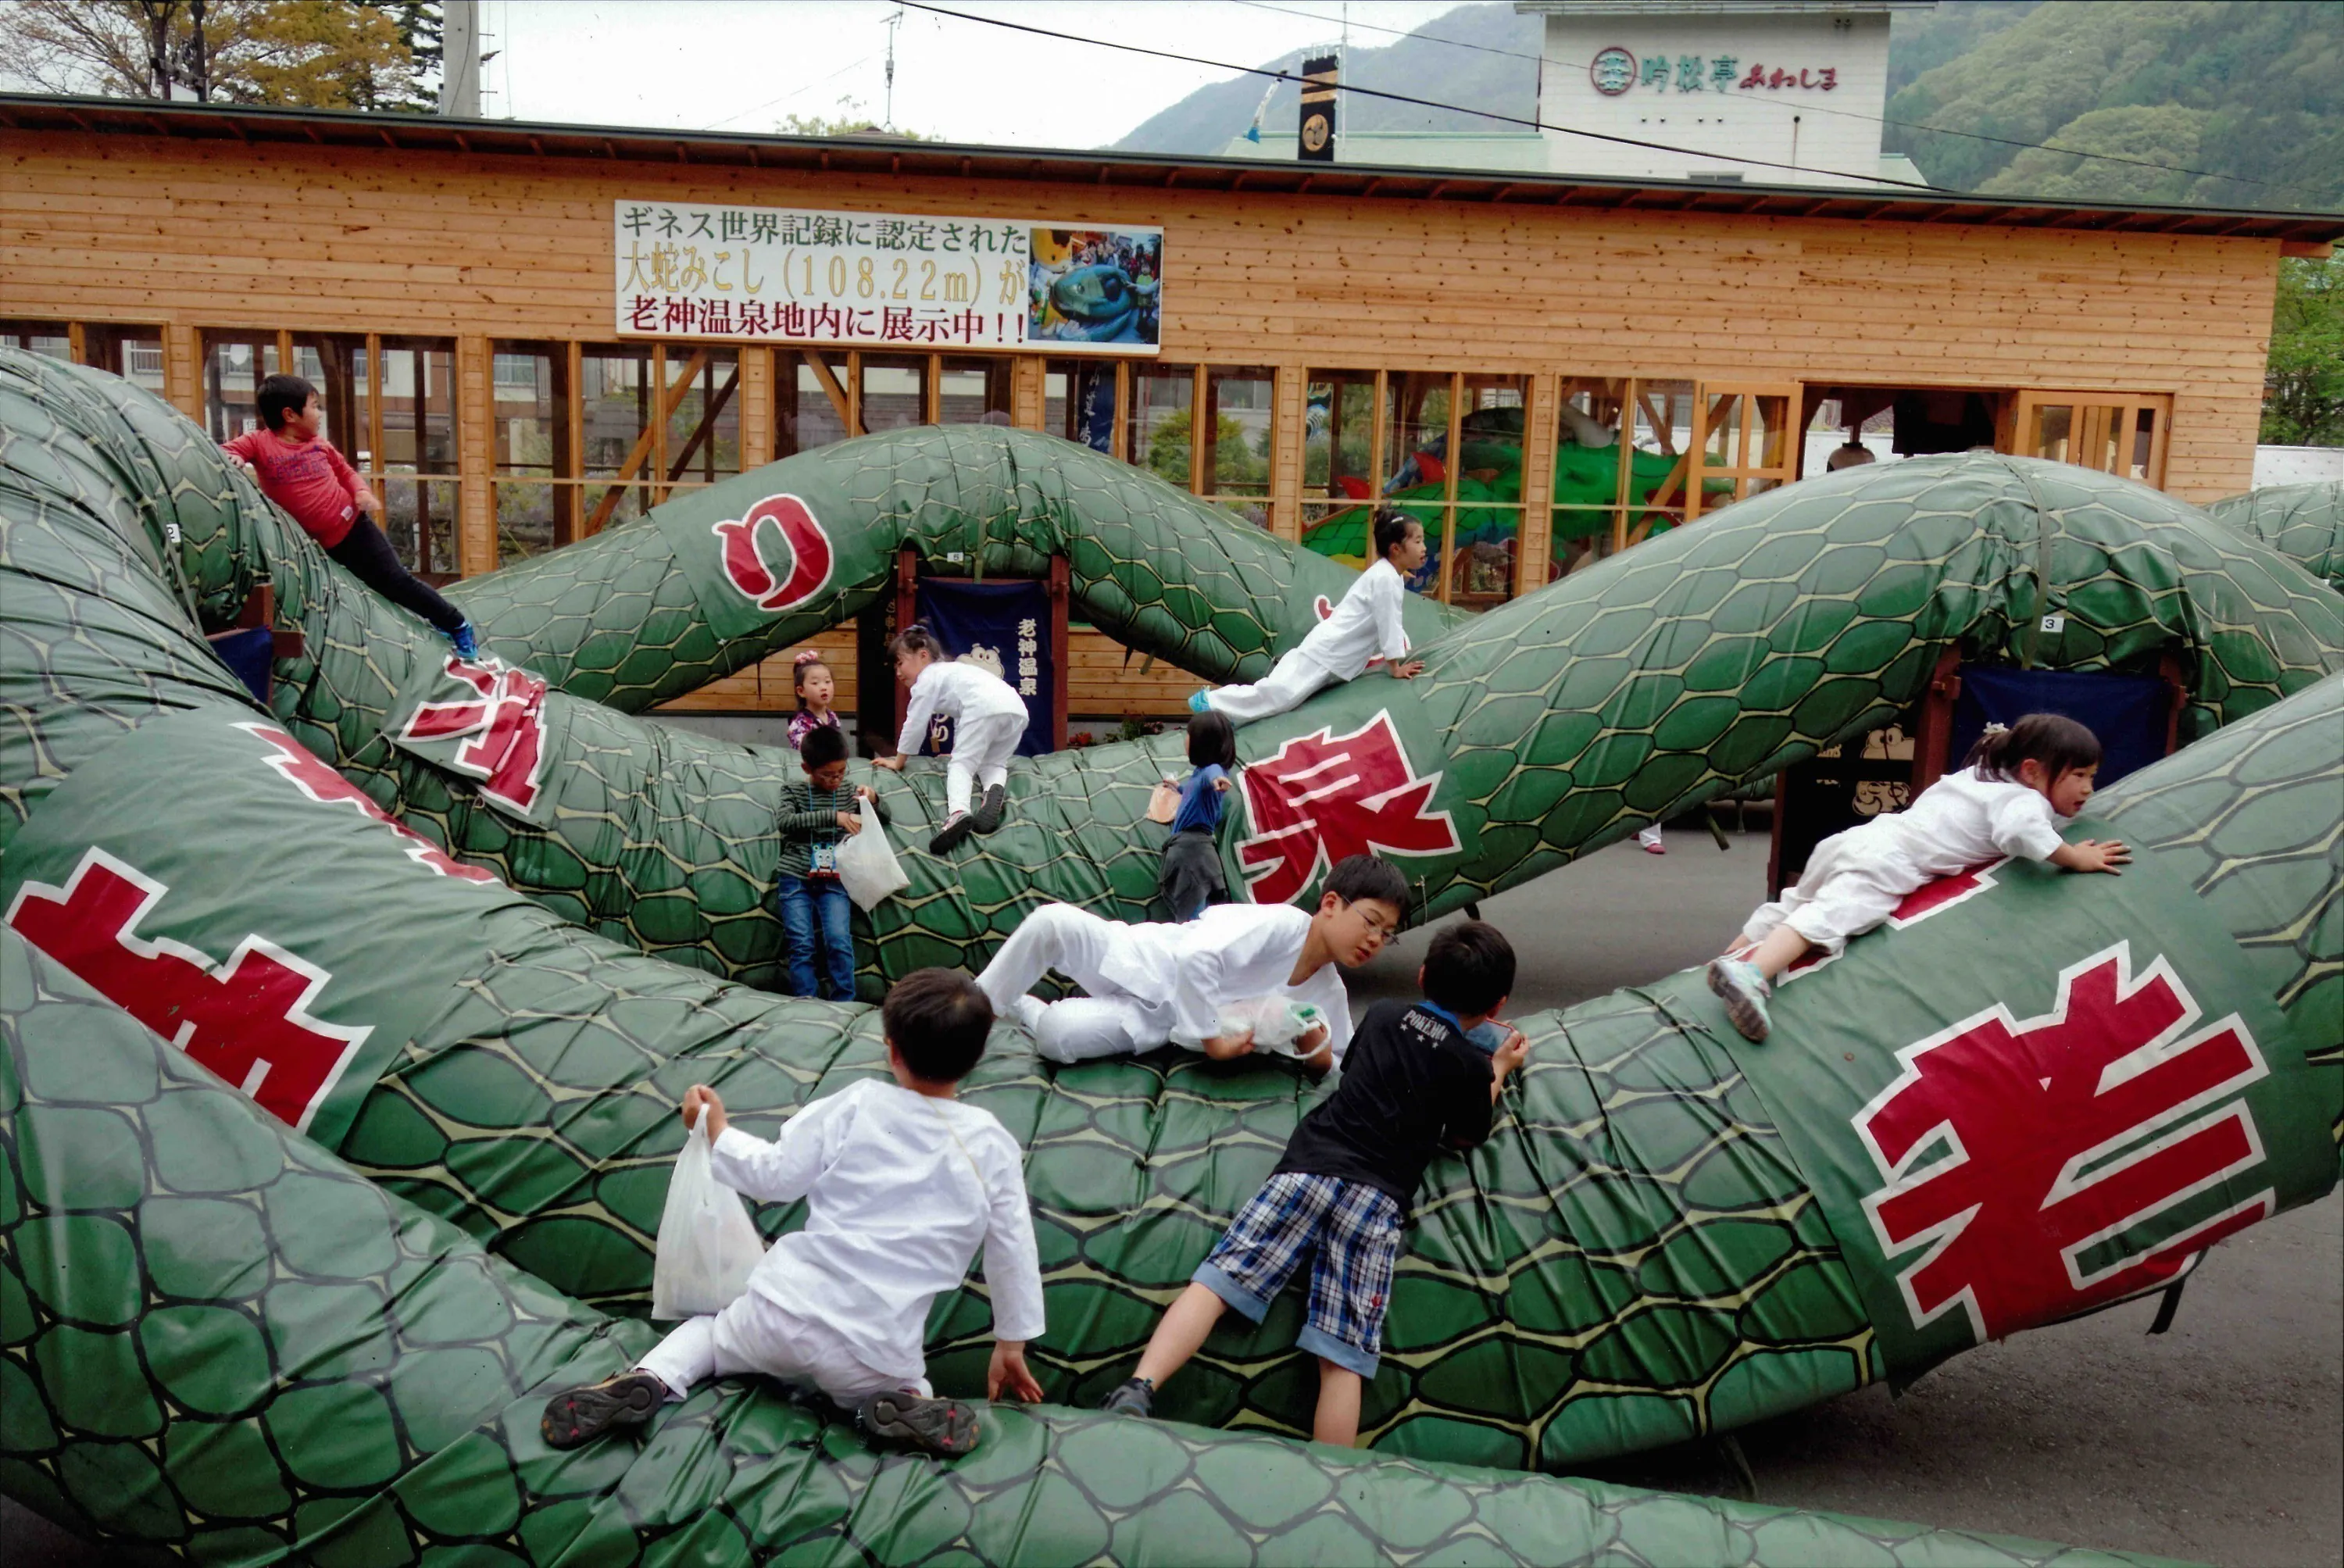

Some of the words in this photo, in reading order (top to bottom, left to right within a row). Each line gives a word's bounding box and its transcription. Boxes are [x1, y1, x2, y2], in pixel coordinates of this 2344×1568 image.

[1641, 54, 1738, 92] 吟松亭
[1739, 63, 1838, 91] あわしま
[622, 206, 1026, 254] ギネス世界記録に認定された
[623, 295, 1024, 344] 老神温泉地内に展示中!!
[712, 492, 834, 611] の
[2046, 619, 2055, 629] 3
[1017, 618, 1038, 696] 老神温泉
[1234, 707, 1463, 905] 泉
[1850, 938, 2275, 1345] 老
